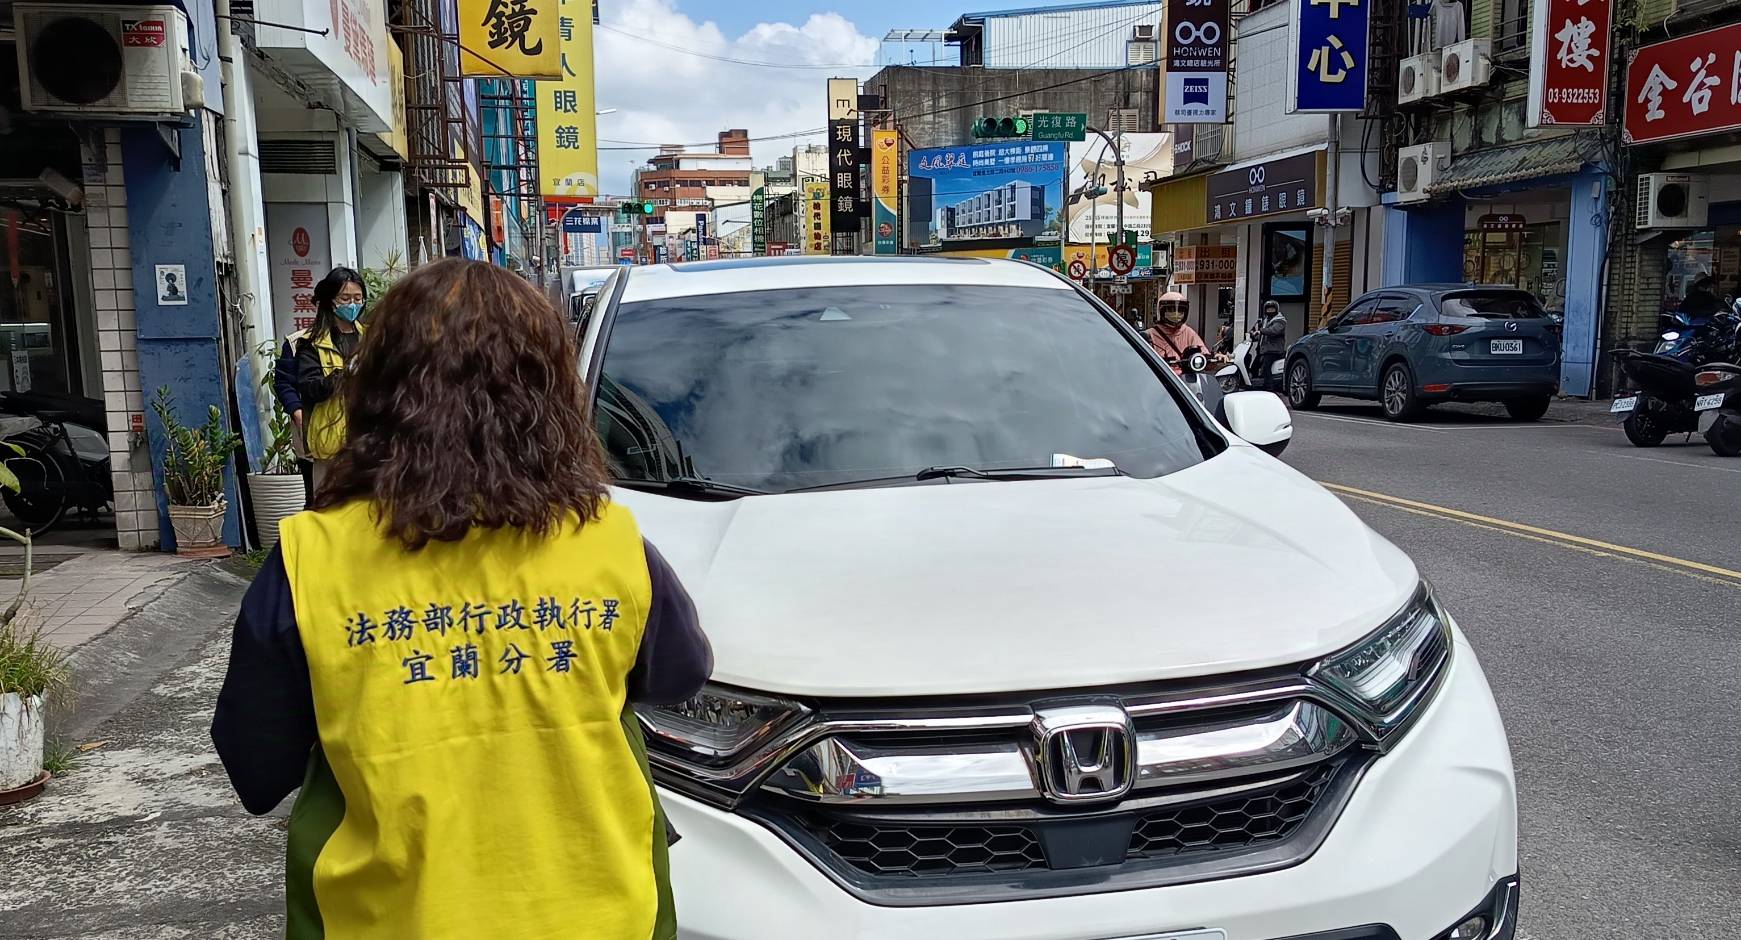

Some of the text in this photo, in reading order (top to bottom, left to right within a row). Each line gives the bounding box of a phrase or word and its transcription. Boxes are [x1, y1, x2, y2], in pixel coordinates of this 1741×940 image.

[481, 0, 543, 56] 鏡
[1173, 47, 1221, 57] HONWEN
[1184, 85, 1208, 93] ZEISS
[1548, 88, 1600, 105] 03-9322553
[1037, 115, 1077, 128] 光復路
[836, 125, 853, 212] 現代眼鏡
[552, 178, 585, 187] 宜蘭店
[345, 597, 620, 647] 法務部行政執行署
[402, 640, 578, 685] 宜蘭分署
